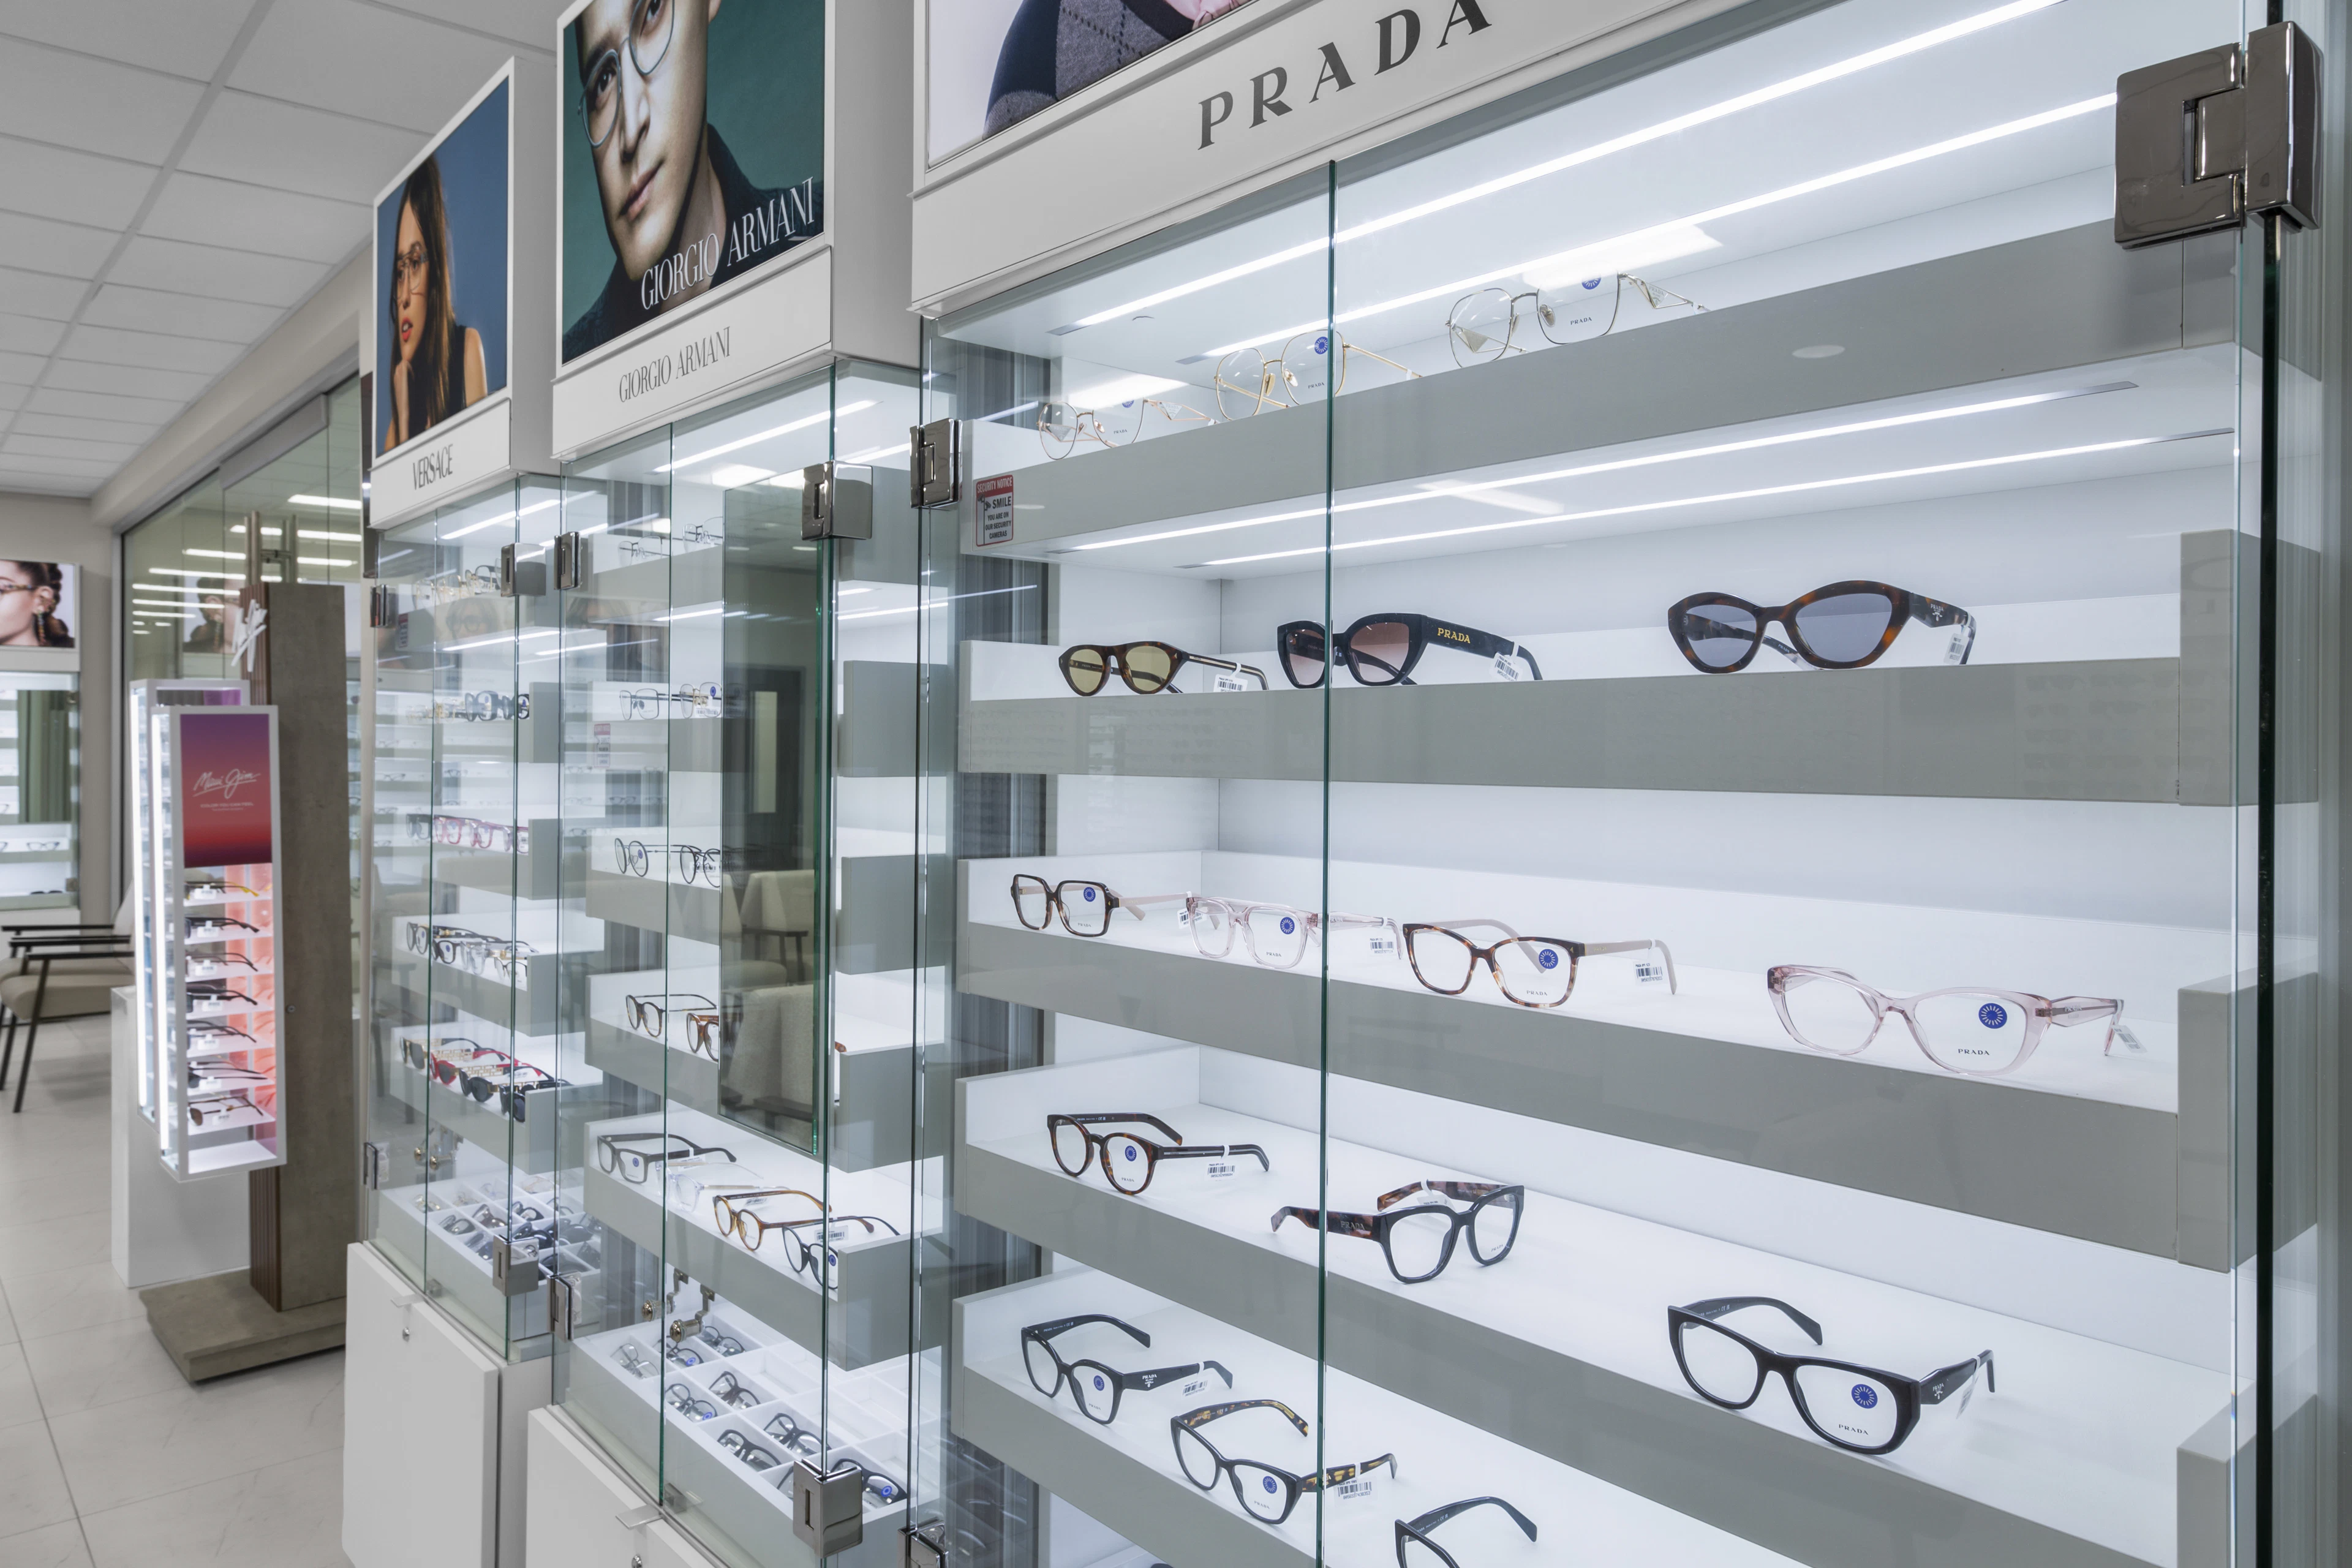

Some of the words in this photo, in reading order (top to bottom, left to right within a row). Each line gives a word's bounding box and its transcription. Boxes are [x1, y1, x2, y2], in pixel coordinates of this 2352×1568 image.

[1198, 0, 1493, 150] PRADA
[641, 233, 720, 311] GIORGIO
[726, 177, 814, 267] ARMANI
[1570, 316, 1593, 325] PRADA
[619, 356, 672, 403] GIORGIO
[676, 326, 731, 380] ARMANI
[413, 444, 453, 490] VERSACE
[977, 481, 996, 493] SECURITY
[997, 477, 1012, 489] NOTICE
[992, 496, 1011, 509] SMILE
[993, 521, 1012, 529] SECURITY
[989, 530, 1008, 539] CAMERAS
[1931, 603, 1944, 612] PRADA
[1438, 627, 1471, 643] PRADA
[193, 771, 224, 791] Maui
[224, 768, 262, 799] Jim
[1341, 1221, 1366, 1231] PRADA
[1491, 1243, 1504, 1253] PRADA
[1933, 1383, 1944, 1392] PRADA
[1838, 1424, 1869, 1435] PRADA
[1254, 1500, 1270, 1510] PRADA
